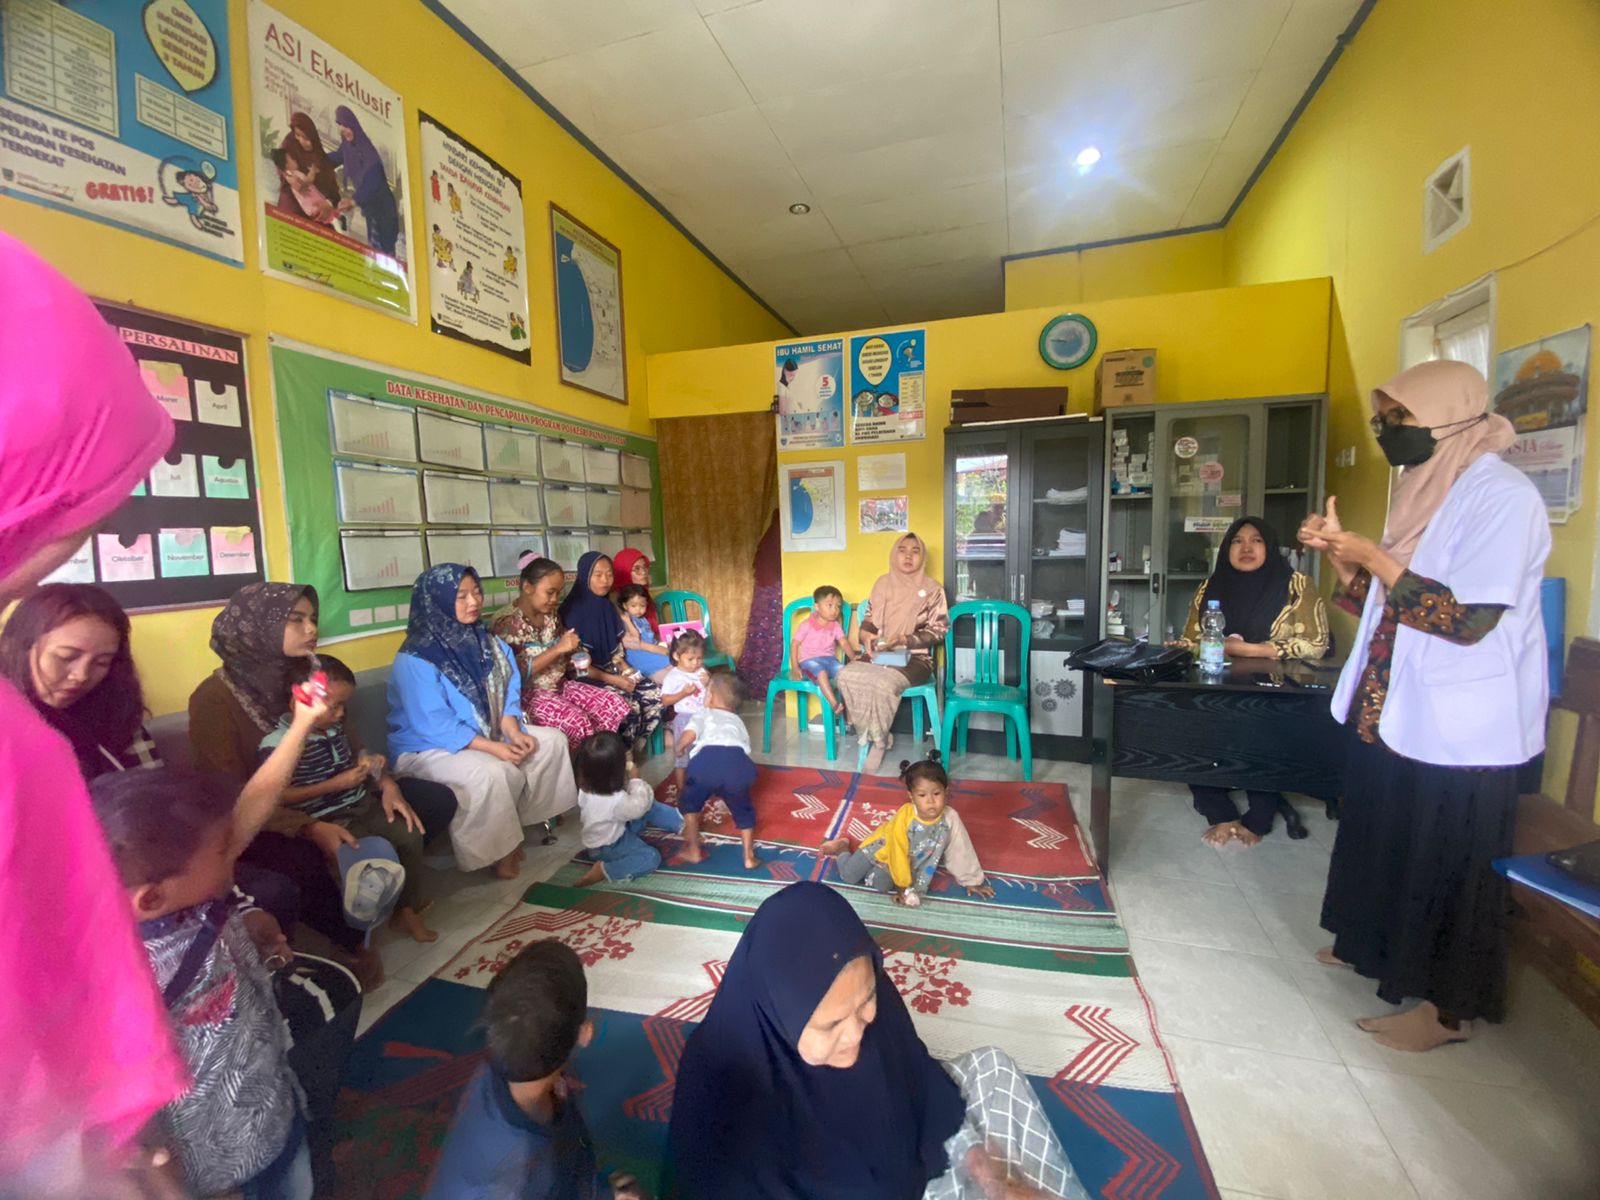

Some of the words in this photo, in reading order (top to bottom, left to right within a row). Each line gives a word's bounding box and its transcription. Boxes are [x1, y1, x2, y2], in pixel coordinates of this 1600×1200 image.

[265, 22, 302, 62] ASI
[311, 49, 392, 119] Eksklusif
[0, 107, 50, 135] SEGERA
[52, 127, 68, 141] KE
[71, 134, 95, 151] POS
[0, 137, 66, 168] TERDEKAT
[59, 143, 126, 176] KESEHATAN
[85, 181, 154, 203] GRATIS!
[121, 329, 236, 362] PERSALINAN
[777, 348, 790, 357] IBU
[792, 345, 815, 355] HAMIL
[817, 342, 842, 352] SEHAT
[822, 377, 829, 387] 5
[212, 402, 228, 410] April
[387, 381, 412, 398] DATA
[415, 388, 465, 408] KESEHATAN
[467, 401, 484, 413] DAN
[485, 406, 529, 423] PENCAPAIAN
[111, 555, 145, 563] Oktober
